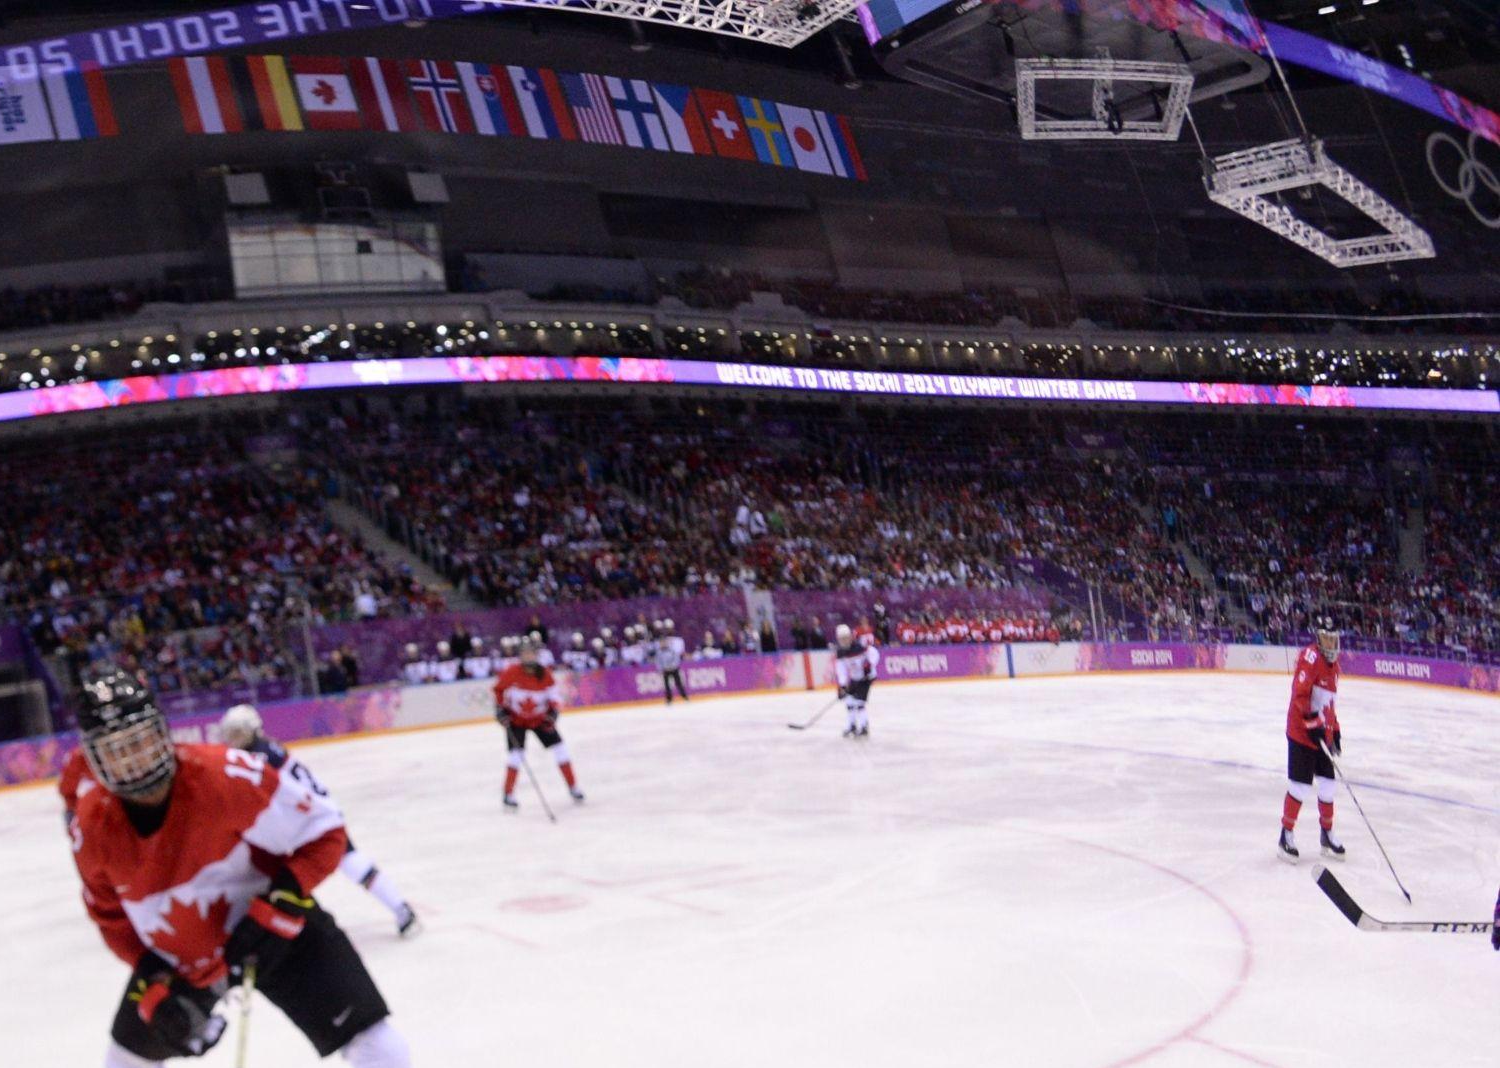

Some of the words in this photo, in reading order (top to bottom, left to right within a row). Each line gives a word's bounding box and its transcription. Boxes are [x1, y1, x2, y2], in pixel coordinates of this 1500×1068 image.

[716, 363, 794, 387] WELCOME
[794, 368, 818, 389] TO
[817, 369, 851, 391] THE
[852, 372, 901, 392] SOCHI
[904, 374, 946, 394] 2014
[950, 376, 1017, 397] OLYMPIC
[1018, 378, 1080, 399] WINTER
[1082, 380, 1137, 400] GAMES
[1374, 659, 1405, 677] SOCHI
[1407, 662, 1431, 679] 2014
[224, 747, 269, 786] 12
[1431, 922, 1489, 933] CCM
